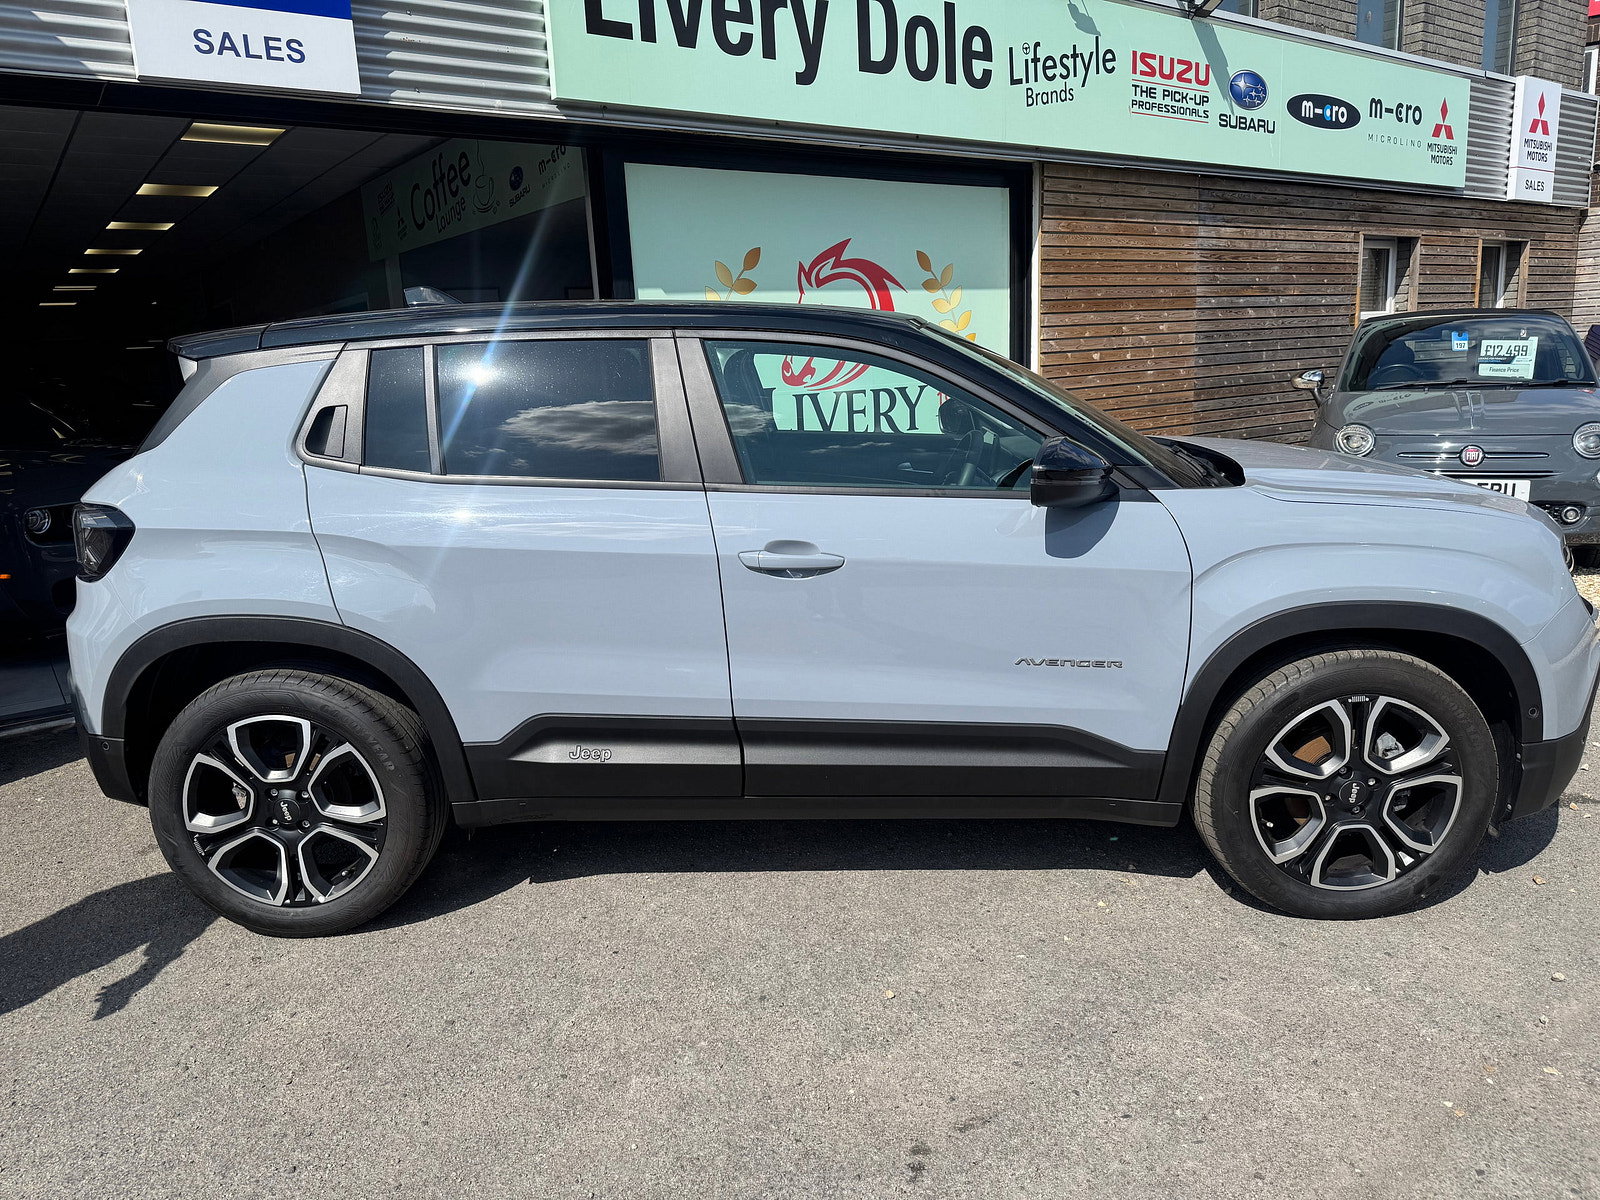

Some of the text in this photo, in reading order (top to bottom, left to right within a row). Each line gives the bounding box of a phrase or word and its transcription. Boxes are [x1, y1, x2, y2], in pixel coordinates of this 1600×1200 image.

[193, 28, 306, 64] SALES
[857, 0, 993, 89] Dole
[1008, 35, 1117, 88] Lifestyle
[1131, 50, 1210, 87] ISUZU
[1025, 82, 1075, 107] Brands
[1131, 84, 1210, 107] THE PICK-UP
[1131, 99, 1210, 119] PROFESSIONALS
[1218, 113, 1276, 134] SUBARU
[1367, 133, 1422, 149] MICROLINO
[1426, 142, 1458, 156] MITSUBISHI
[1523, 137, 1553, 152] MITSUBISHI
[1430, 154, 1454, 166] MOTORS
[1526, 150, 1549, 163] MOTORS
[410, 151, 472, 232] Coffee
[508, 183, 532, 208] SUBARU
[1524, 179, 1545, 192] SALES
[434, 195, 467, 235] Lounge
[1466, 451, 1479, 461] FIAT
[1014, 657, 1123, 669] AVENGER
[568, 744, 612, 762] Jeep
[1349, 783, 1360, 803] Jeep
[280, 801, 293, 823] Jeep
